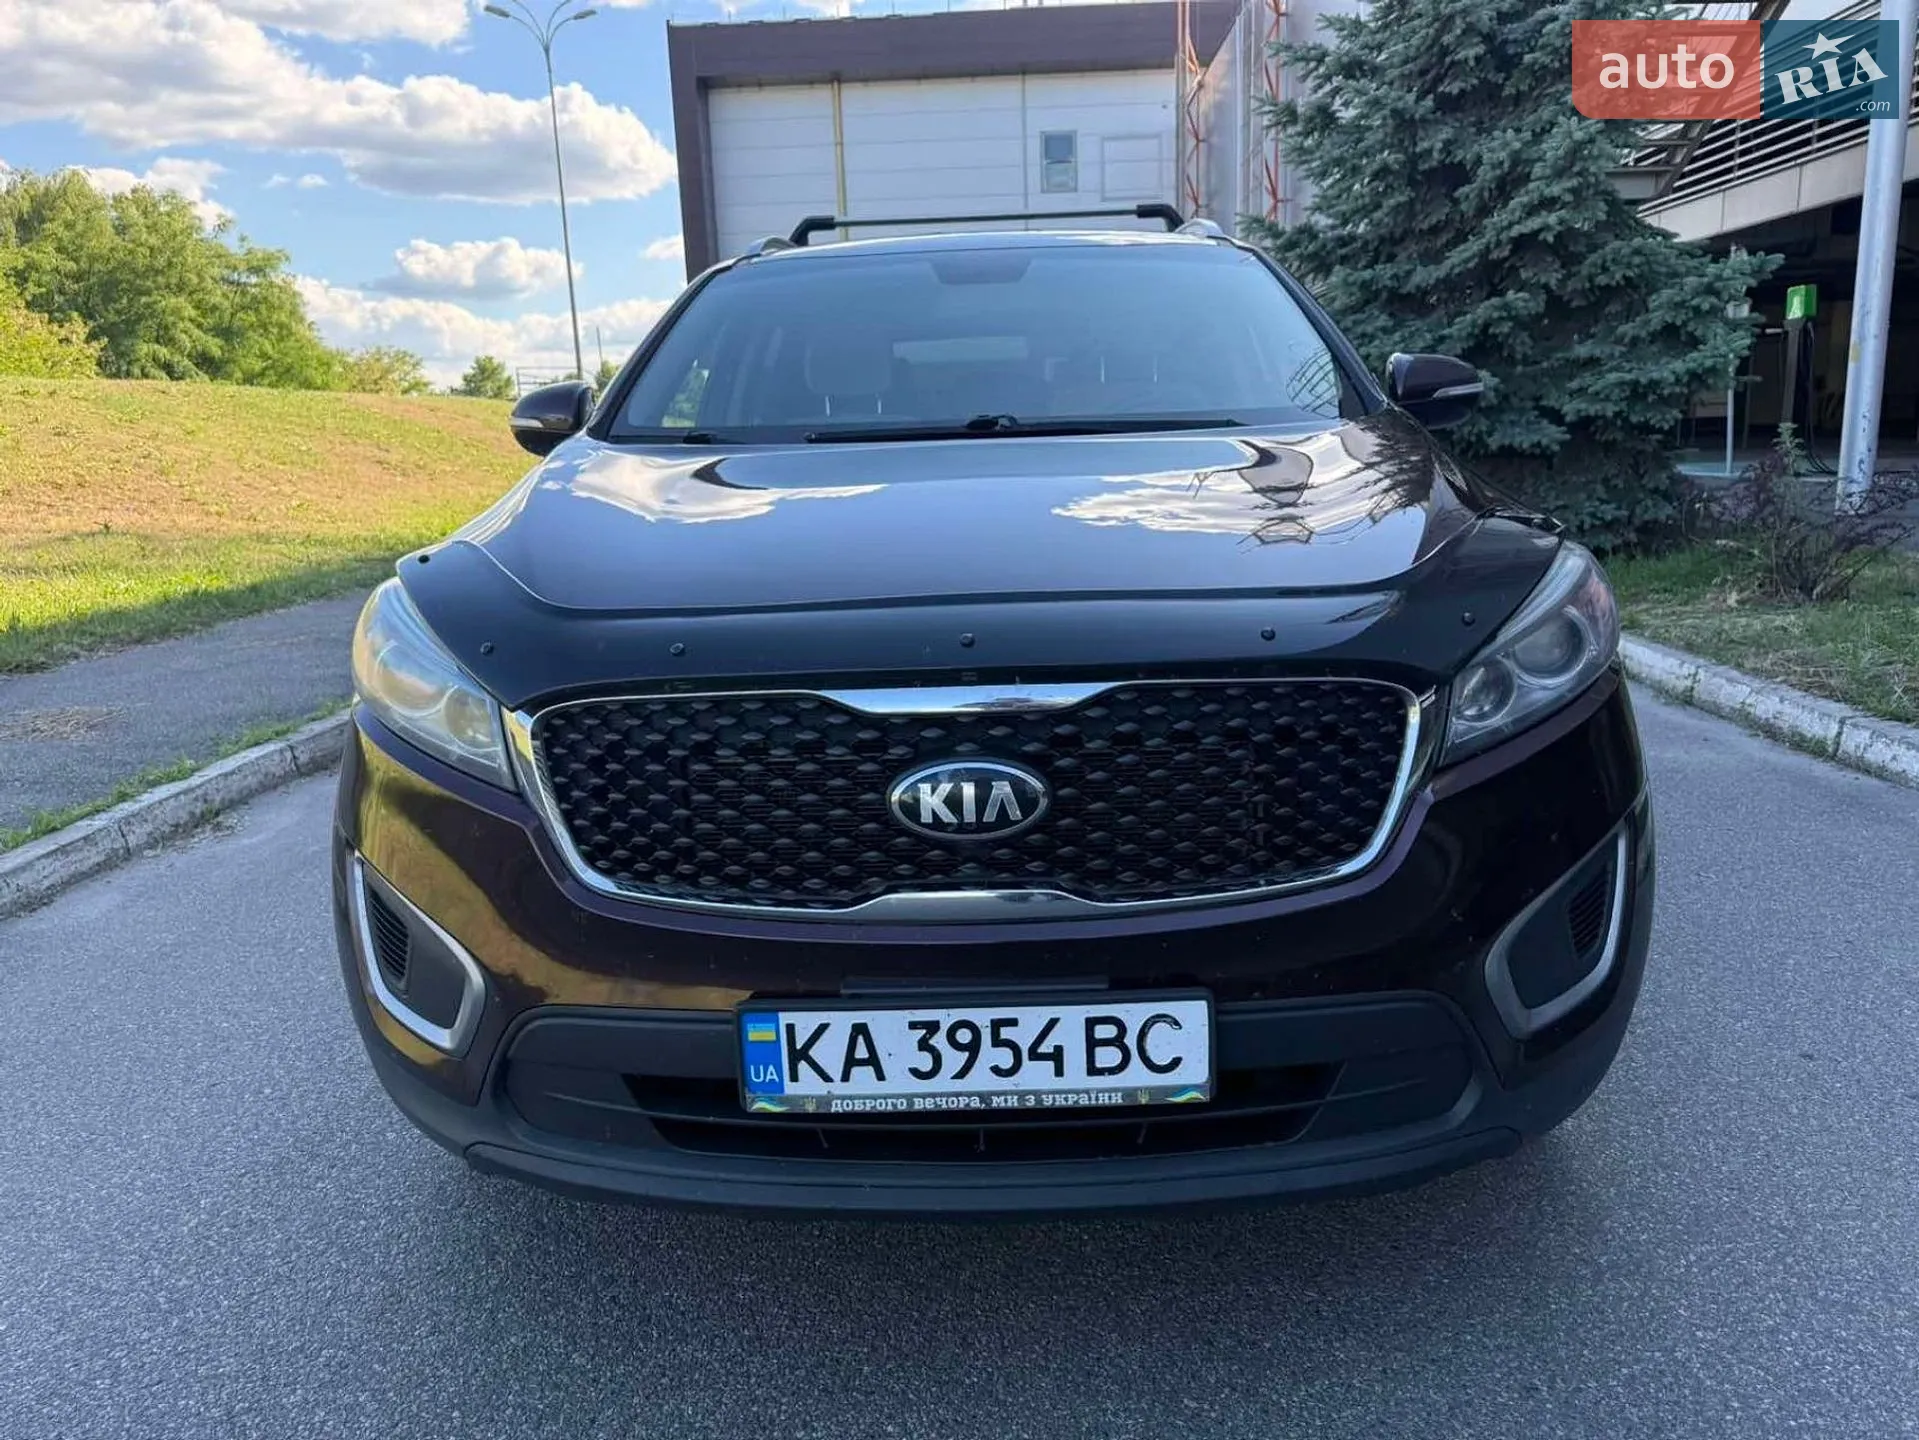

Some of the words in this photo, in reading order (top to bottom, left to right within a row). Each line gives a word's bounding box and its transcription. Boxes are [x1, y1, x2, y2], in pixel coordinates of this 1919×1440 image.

[917, 780, 1024, 824] KIA
[785, 1021, 887, 1083] KA
[907, 1016, 1065, 1080] 3954
[1084, 1012, 1184, 1078] BC
[749, 1064, 780, 1083] UA
